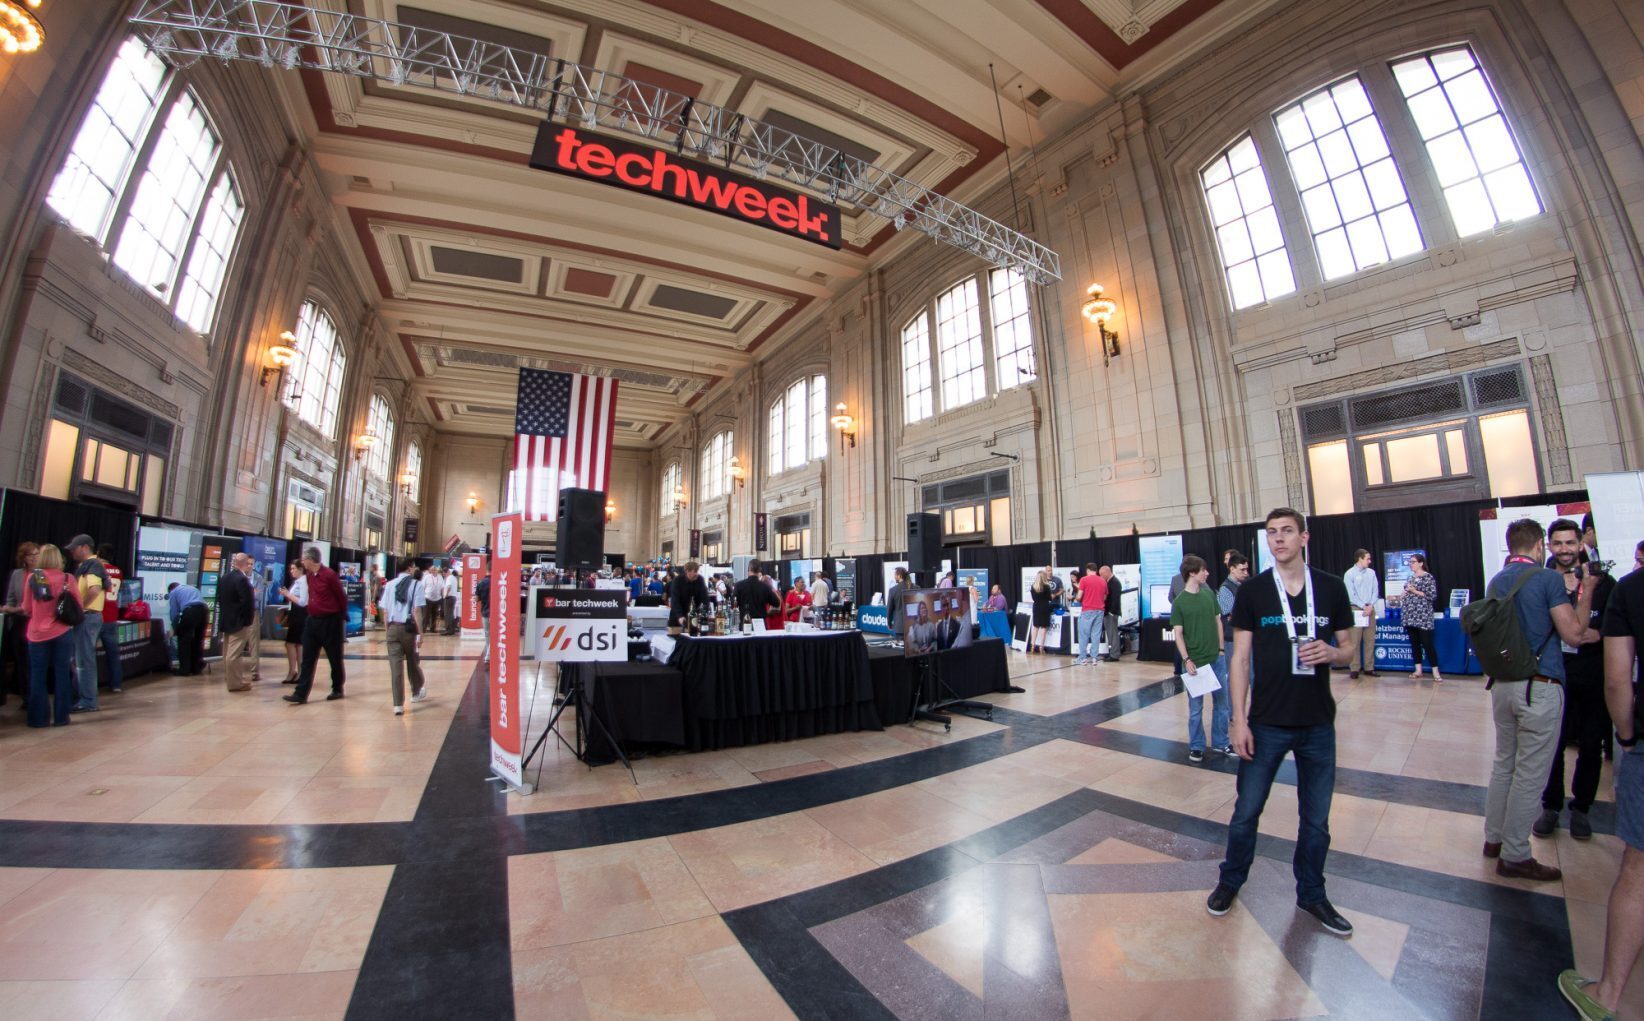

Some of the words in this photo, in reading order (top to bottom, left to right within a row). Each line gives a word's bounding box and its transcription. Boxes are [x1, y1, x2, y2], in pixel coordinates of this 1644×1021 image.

[555, 128, 829, 241] techweek
[555, 598, 571, 608] bar
[573, 598, 619, 608] techweek
[497, 570, 508, 685] techweek
[577, 624, 617, 651] dsi
[498, 687, 508, 728] bar
